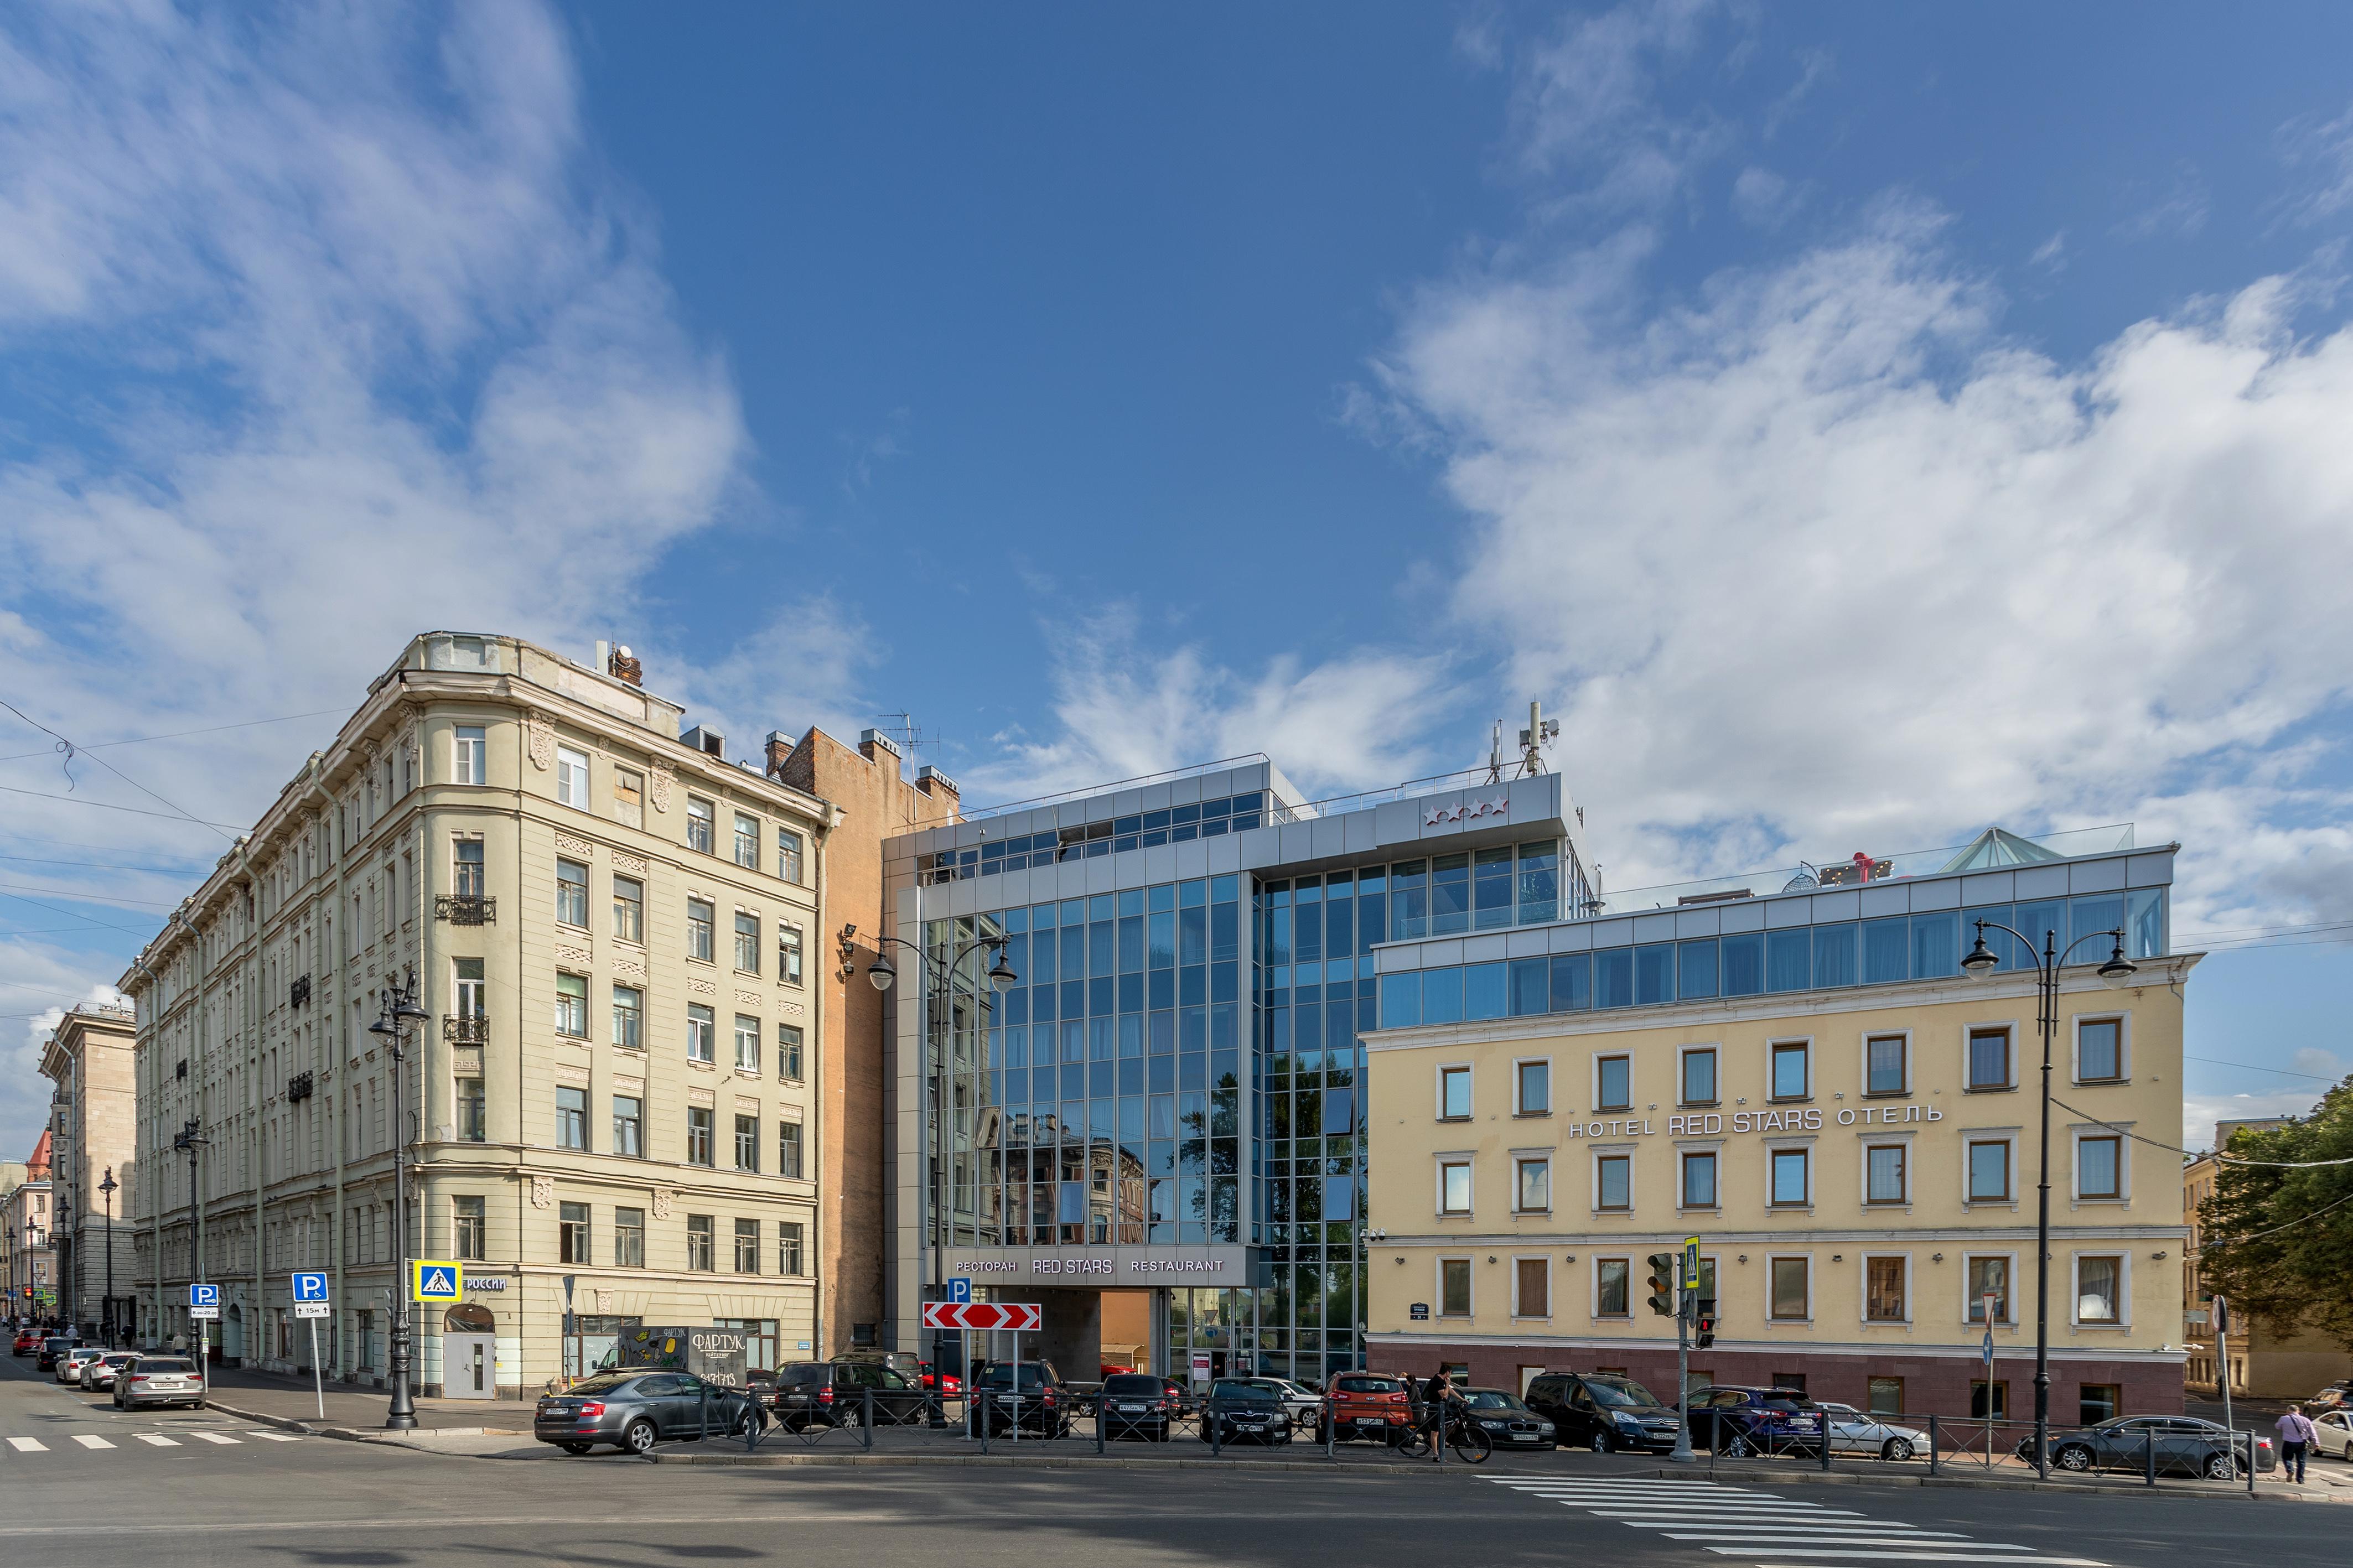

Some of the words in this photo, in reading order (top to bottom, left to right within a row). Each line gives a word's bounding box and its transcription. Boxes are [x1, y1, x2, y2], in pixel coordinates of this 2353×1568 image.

[1569, 1119, 1655, 1138] HOTEL
[1668, 1114, 1722, 1135] RED
[1733, 1109, 1822, 1133] STARS
[1837, 1105, 1943, 1125] ОТЕЛЬ
[956, 1261, 1017, 1272] РЕСТОРАН
[1033, 1259, 1061, 1273] RED
[1066, 1259, 1112, 1273] STARS
[1131, 1261, 1224, 1271] RESTAURANT
[467, 1278, 506, 1289] РОССИИ
[664, 1328, 686, 1337] ФАРТУК
[692, 1333, 745, 1350] ФАРТУК
